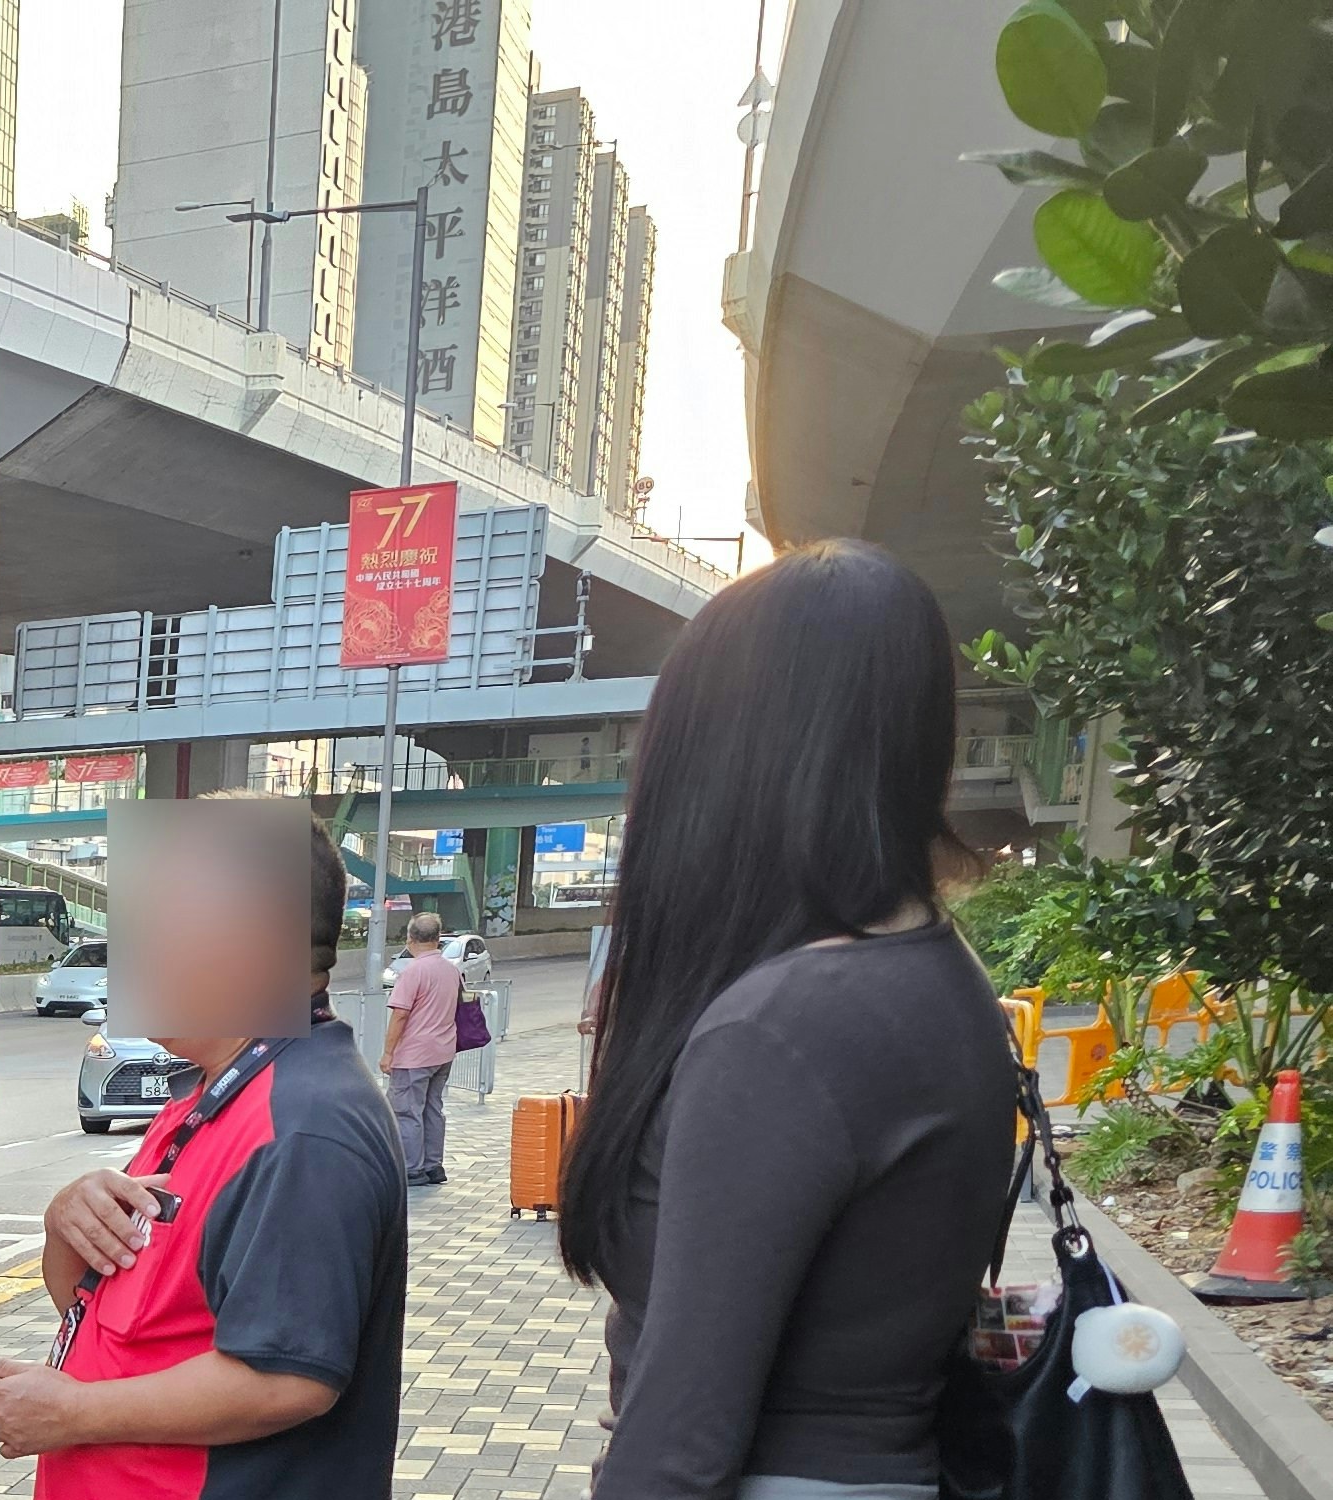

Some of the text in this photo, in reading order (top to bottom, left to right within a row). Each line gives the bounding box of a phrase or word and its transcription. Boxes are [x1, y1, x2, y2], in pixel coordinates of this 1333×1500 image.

[376, 492, 433, 550] 77
[361, 546, 438, 570] 熱烈慶祝
[1258, 1141, 1301, 1161] 警察
[1248, 1170, 1303, 1190] POLIC
